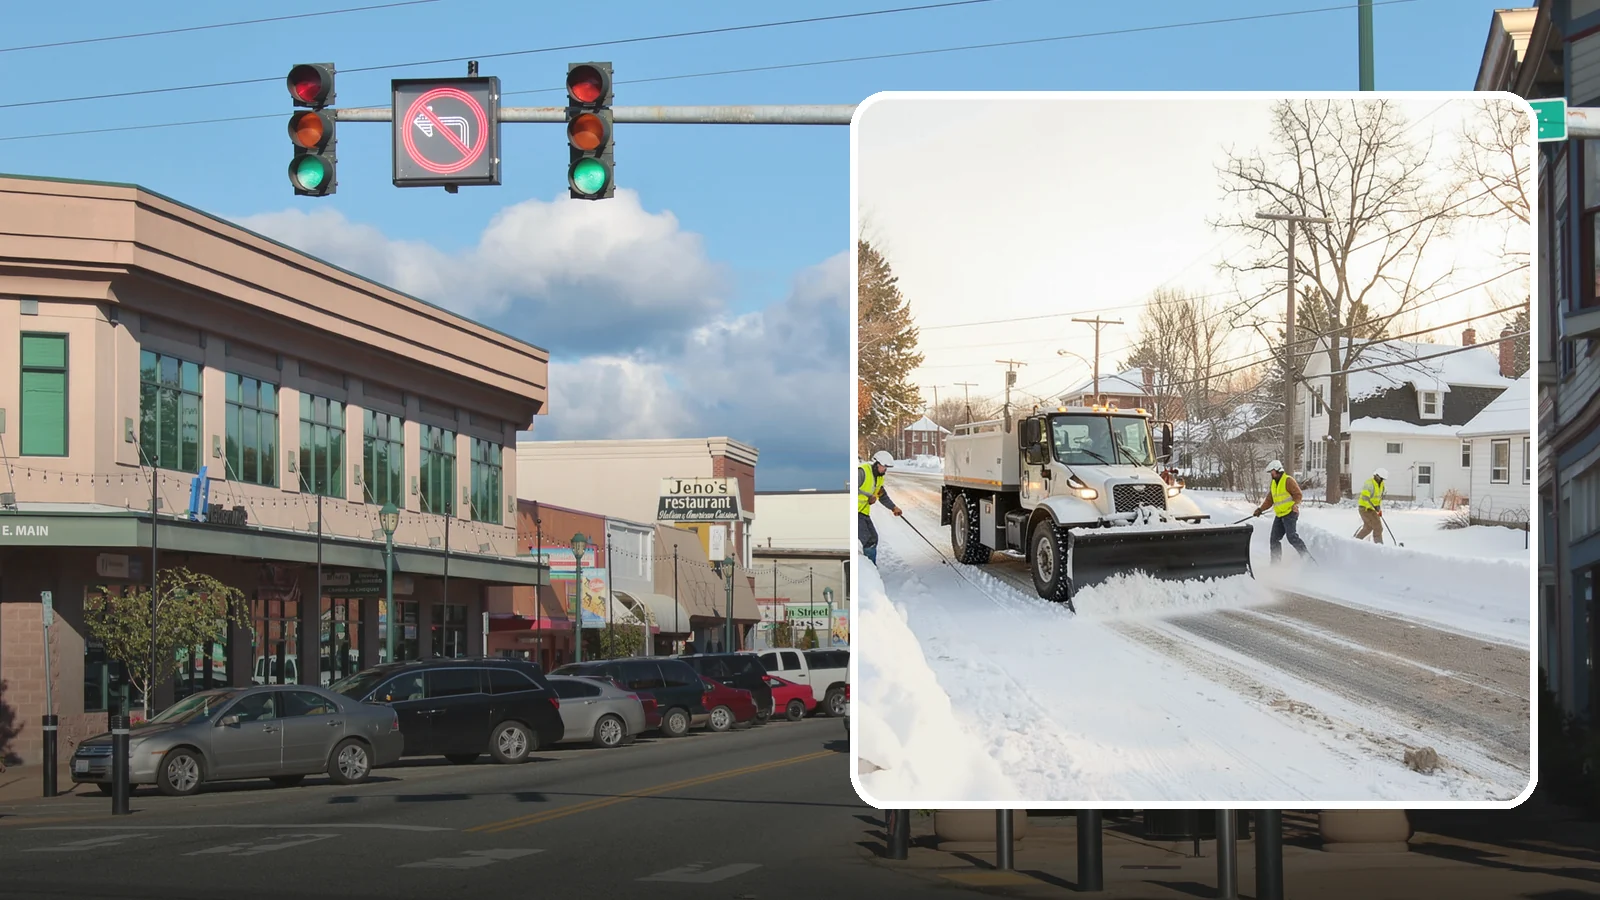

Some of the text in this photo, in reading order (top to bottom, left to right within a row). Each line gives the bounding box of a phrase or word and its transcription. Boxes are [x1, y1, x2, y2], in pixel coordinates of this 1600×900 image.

[670, 480, 727, 494] Jeno's
[665, 496, 731, 509] restaurant
[658, 510, 682, 520] Italian
[686, 509, 715, 520] American
[714, 509, 737, 520] Cuisine
[2, 525, 49, 536] E. MAIN
[797, 607, 829, 616] Street
